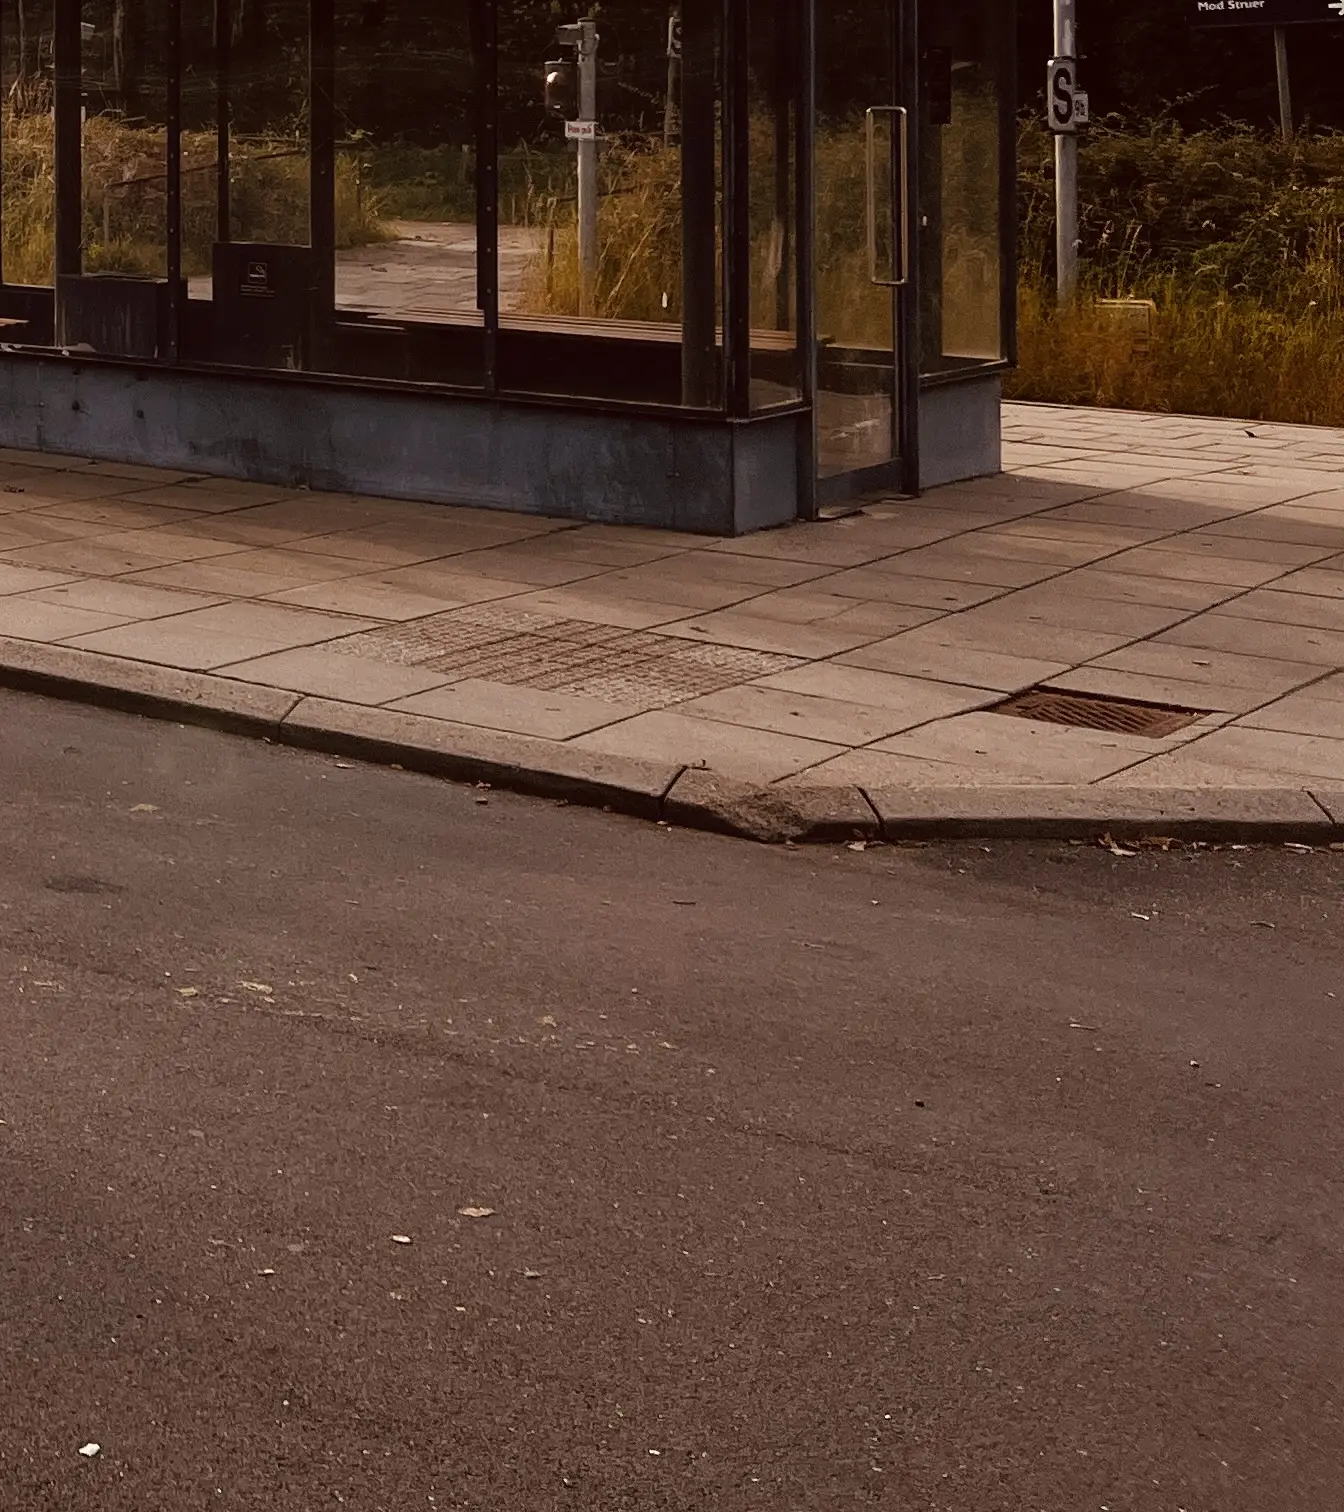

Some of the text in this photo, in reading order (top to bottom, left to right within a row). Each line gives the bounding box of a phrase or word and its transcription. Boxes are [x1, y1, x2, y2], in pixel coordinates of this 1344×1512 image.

[1197, 0, 1265, 12] Mod Struer
[1052, 67, 1072, 125] S
